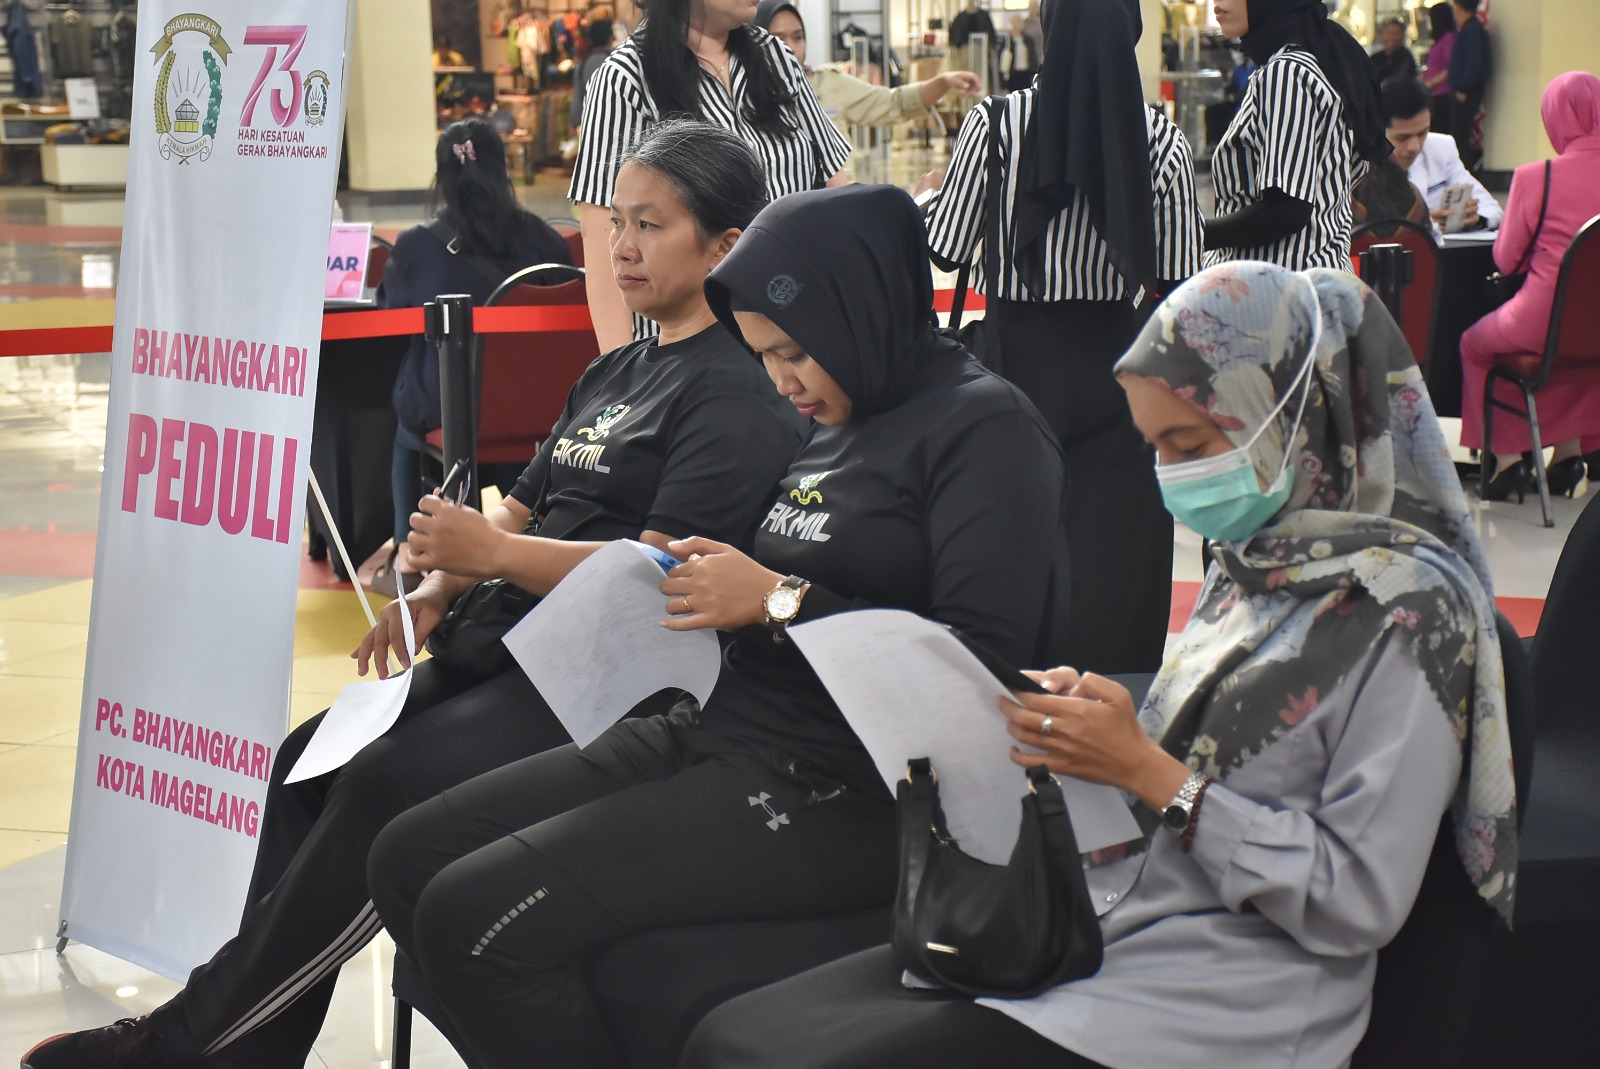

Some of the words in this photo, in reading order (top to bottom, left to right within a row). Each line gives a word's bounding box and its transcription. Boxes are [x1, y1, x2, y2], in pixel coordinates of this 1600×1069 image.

[166, 18, 219, 37] BHAYANGKARI
[240, 25, 308, 127] 73
[166, 136, 186, 154] KEMALA
[185, 138, 208, 154] HIKMAH
[237, 144, 266, 157] GERAK
[267, 145, 328, 159] BHAYANGKARI
[238, 128, 259, 141] HARI
[260, 130, 305, 143] KESATUAN
[131, 327, 309, 398] BHAYANGKARI
[551, 438, 611, 474] AKMIL
[121, 412, 298, 544] PEDULI
[760, 502, 831, 542] AKMIL
[95, 698, 128, 739] PC.
[132, 707, 272, 783] BHAYANGKARI
[96, 753, 145, 801] KOTA
[150, 772, 260, 838] MAGELANG
